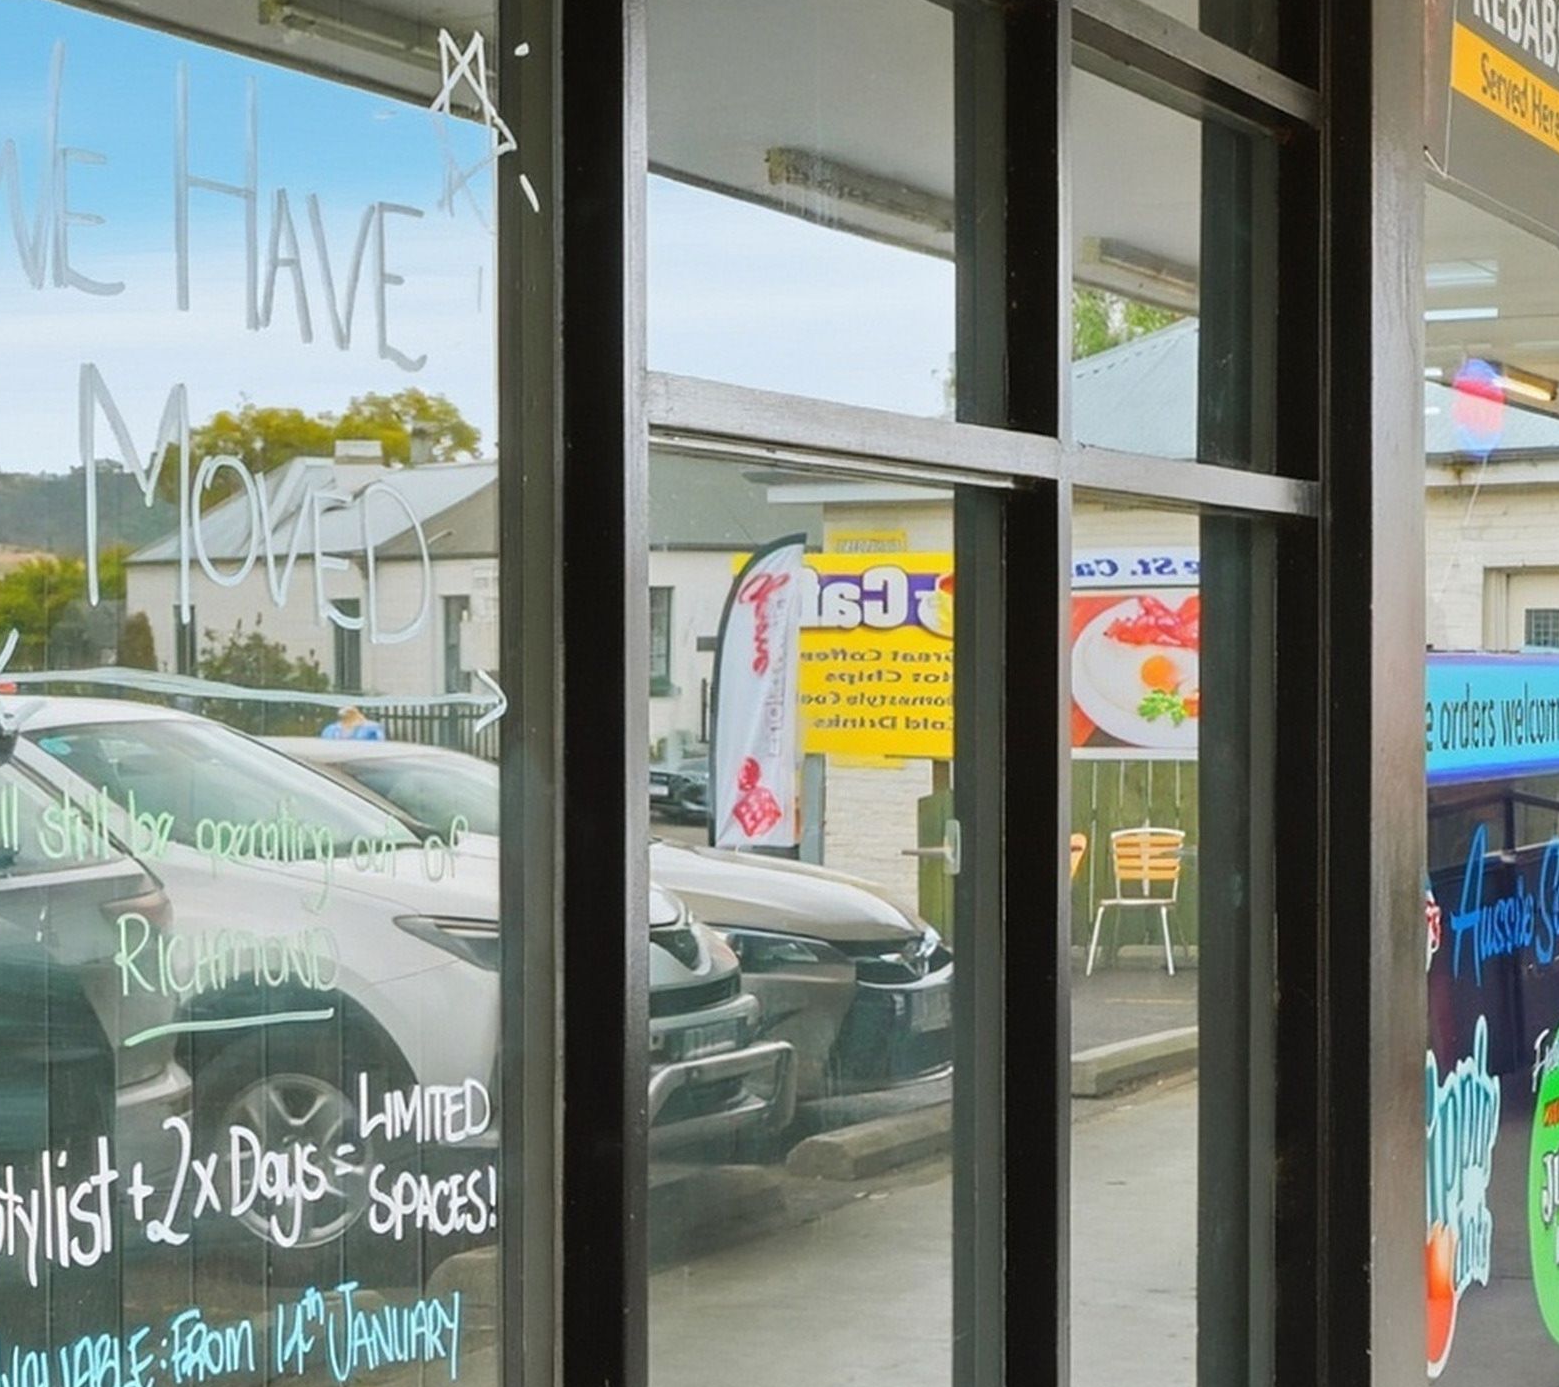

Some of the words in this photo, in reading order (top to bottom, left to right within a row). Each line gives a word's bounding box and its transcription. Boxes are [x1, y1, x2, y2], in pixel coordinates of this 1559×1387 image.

[1481, 52, 1528, 120] Served
[175, 59, 429, 372] HAVE
[79, 362, 432, 646] MOVED
[1440, 683, 1496, 750] orders
[38, 776, 111, 860] still
[126, 790, 175, 860] be
[196, 792, 335, 913] operating
[352, 823, 403, 876] out
[424, 814, 469, 881] of
[1450, 823, 1534, 987] Aussie
[357, 1072, 492, 1144] LIMITED
[230, 1121, 331, 1249] Days
[368, 1164, 500, 1240] SPACES!
[327, 1281, 462, 1384] JANUARY
